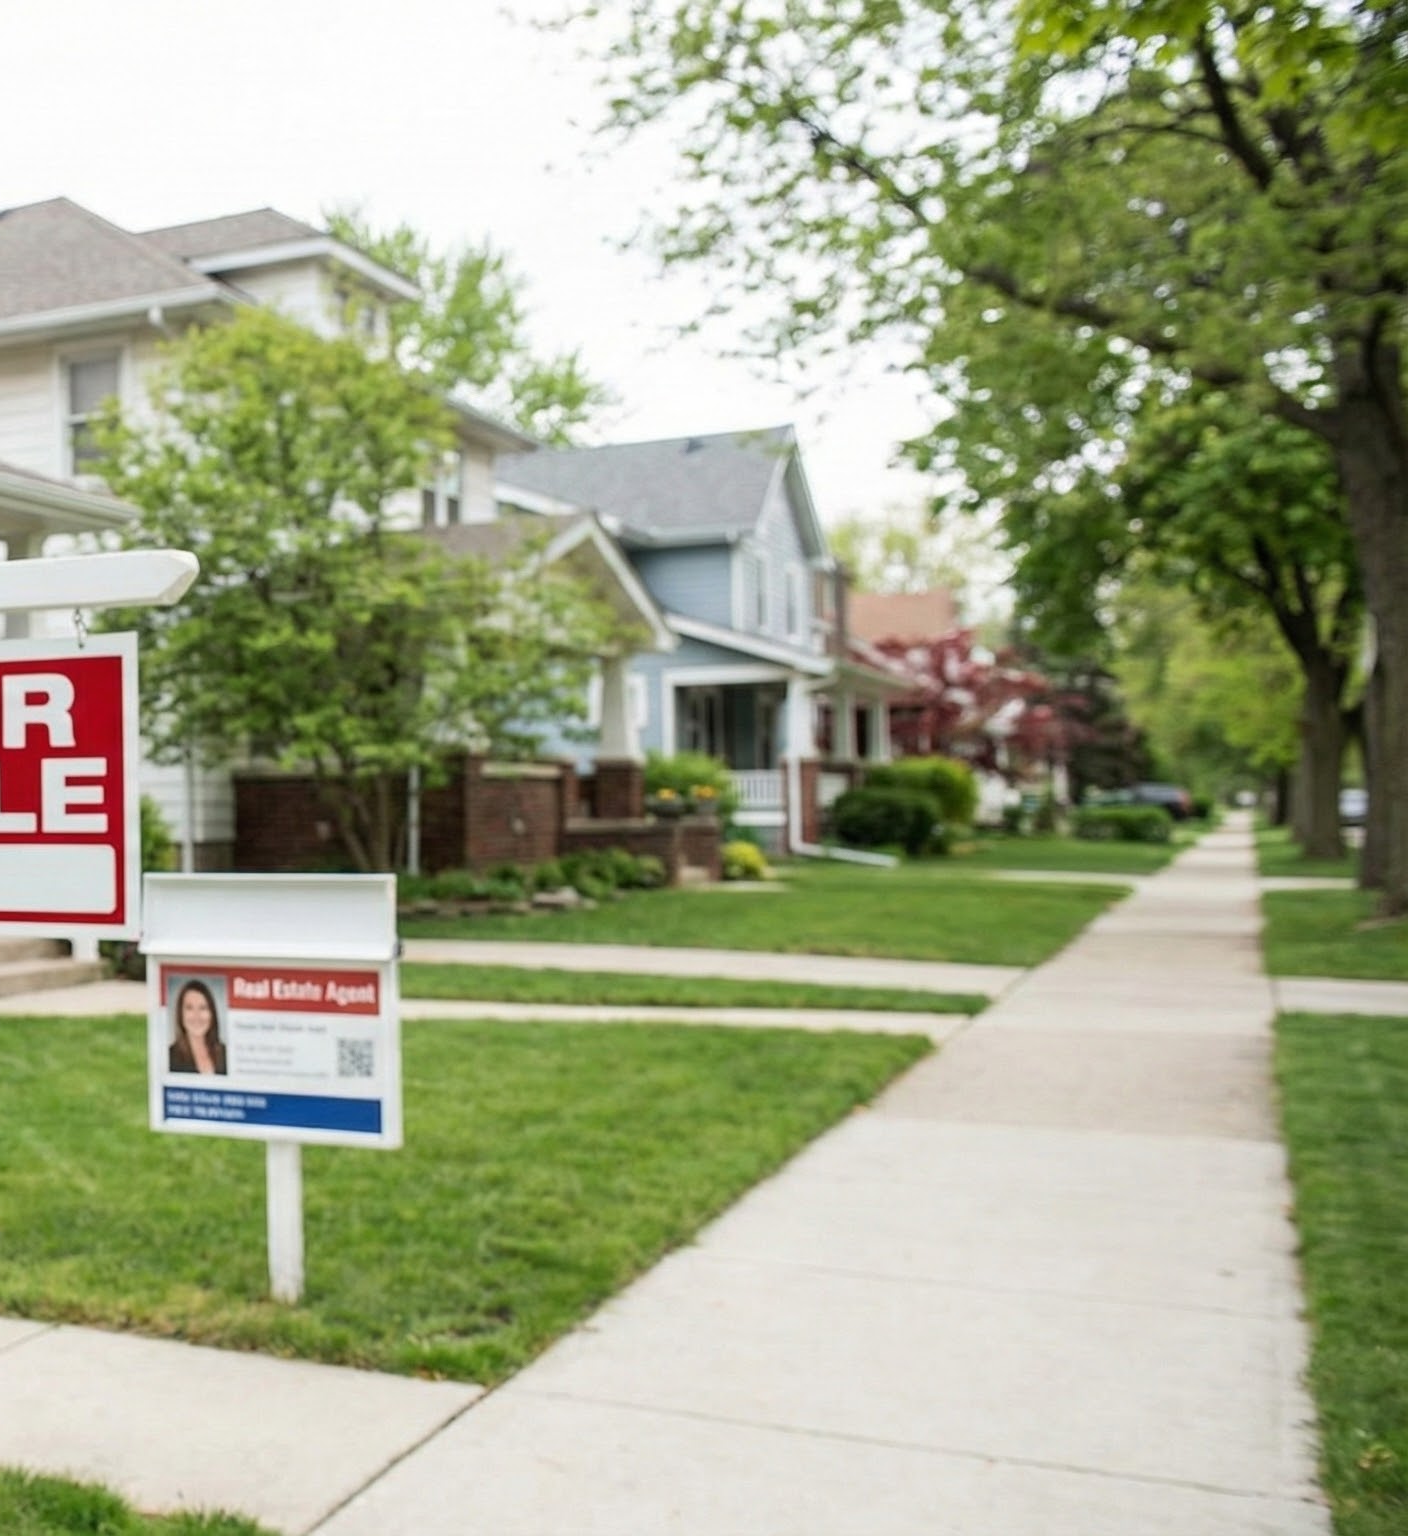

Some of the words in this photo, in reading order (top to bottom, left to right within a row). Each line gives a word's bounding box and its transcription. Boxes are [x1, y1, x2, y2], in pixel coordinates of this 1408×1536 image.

[233, 976, 270, 999] Real
[272, 977, 322, 1002] Estate
[325, 980, 376, 1007] Agent
